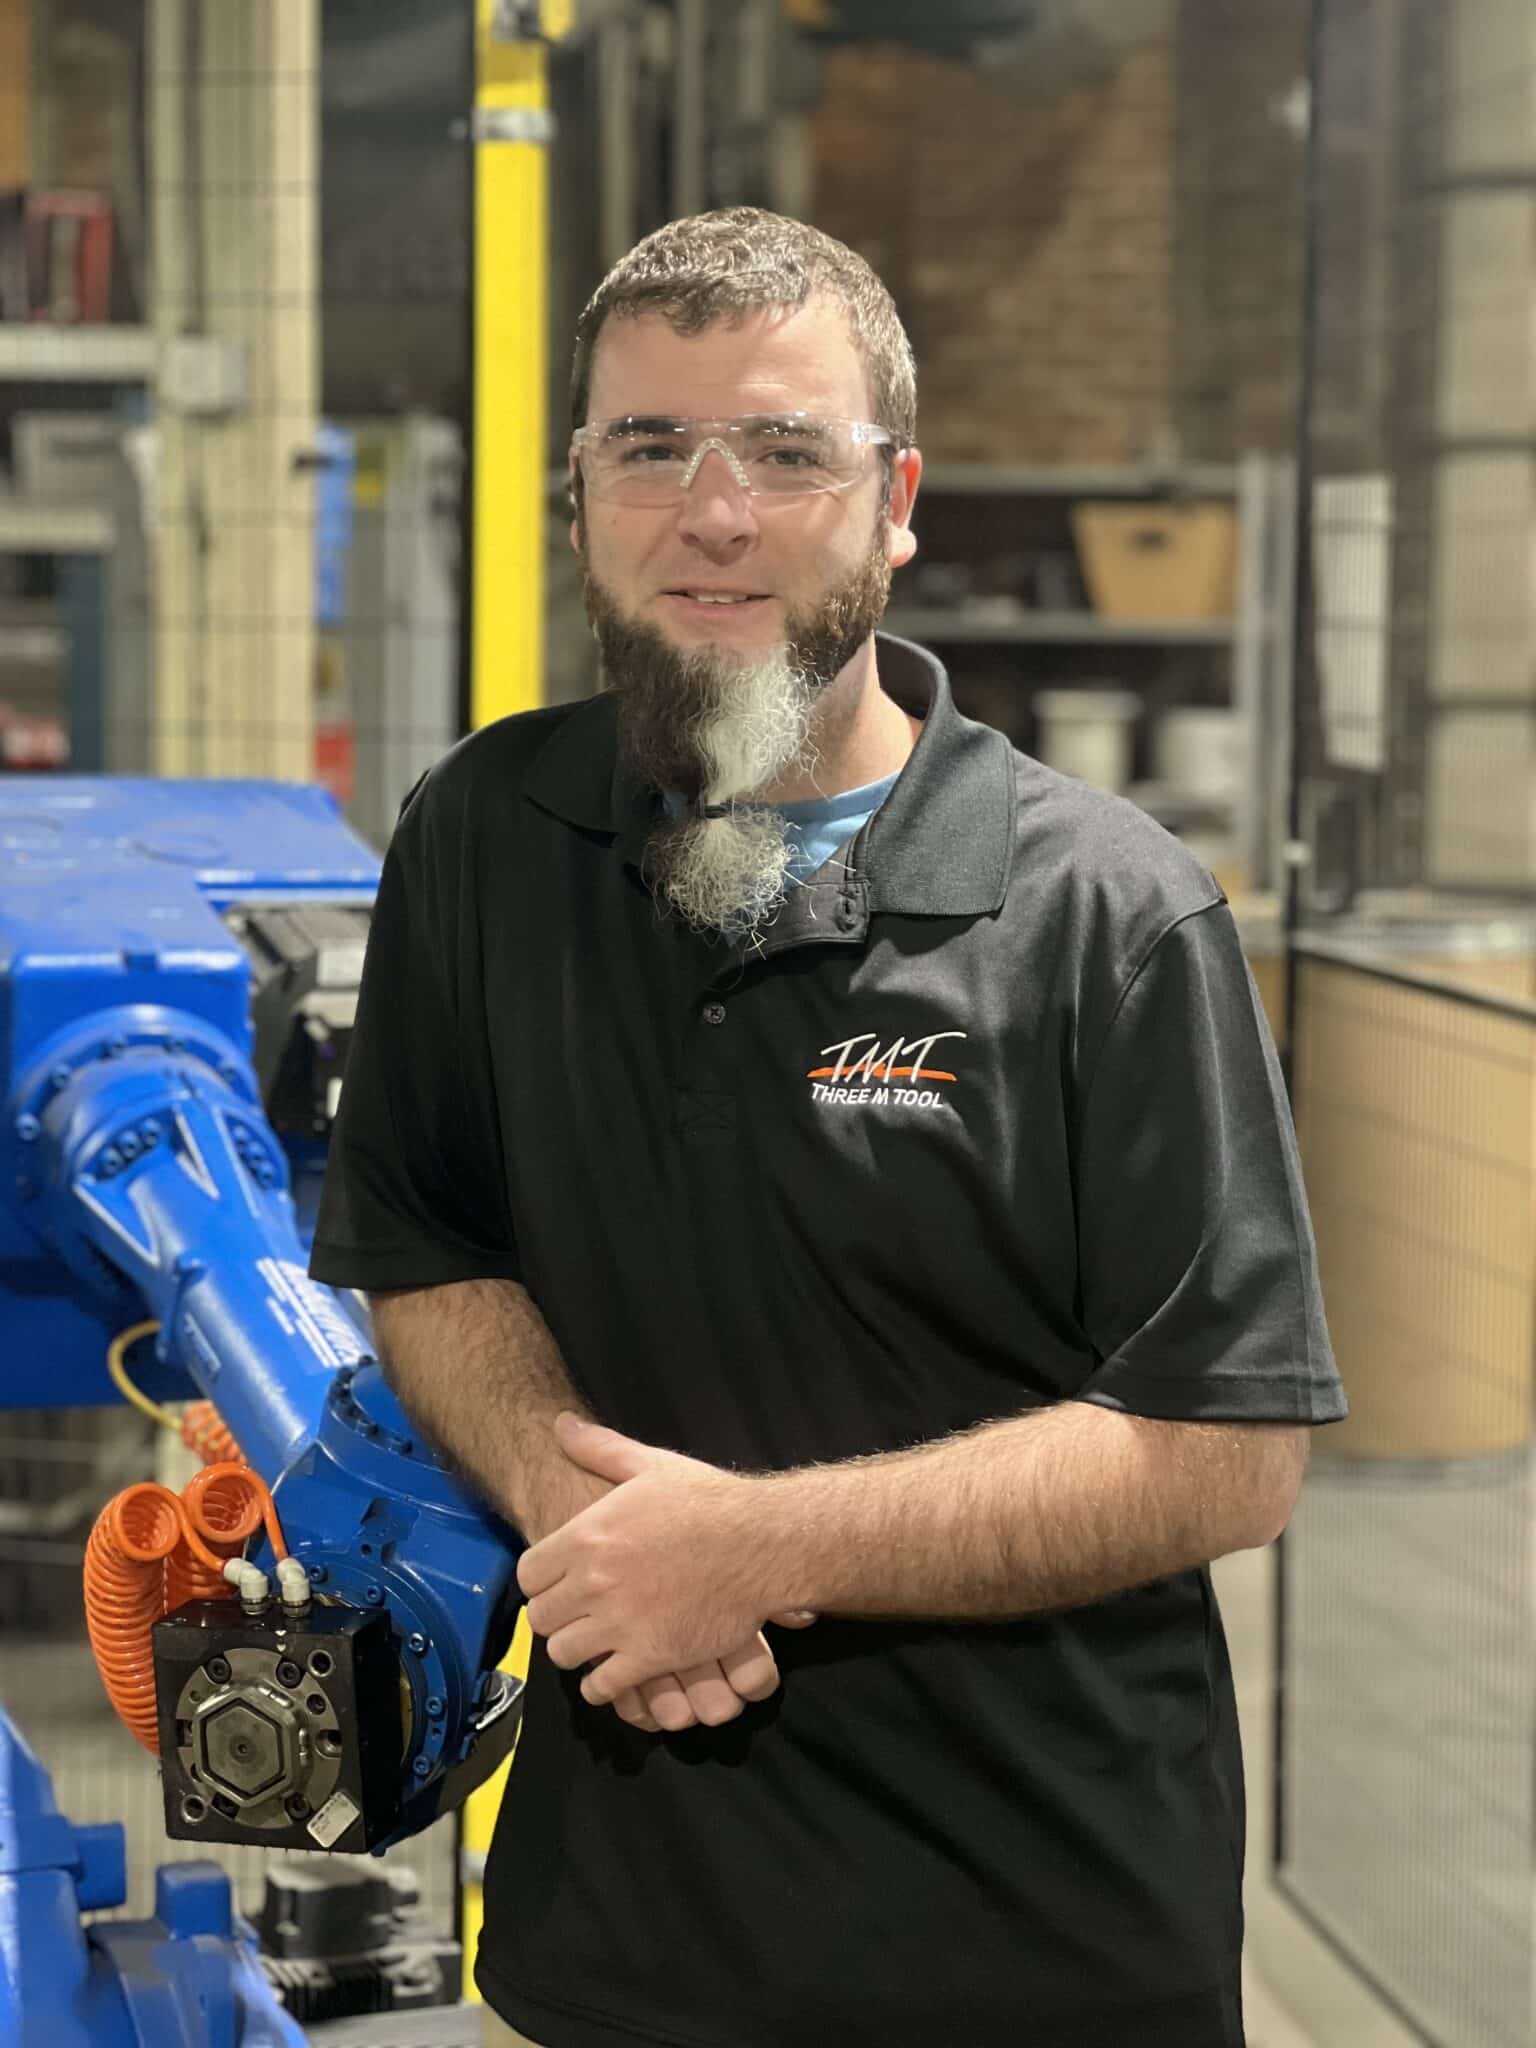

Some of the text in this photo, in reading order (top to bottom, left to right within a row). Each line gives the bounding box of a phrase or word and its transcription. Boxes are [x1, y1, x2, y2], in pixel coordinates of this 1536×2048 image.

[820, 1031, 968, 1084] TMT
[811, 1082, 944, 1108] THREE M TOOL
